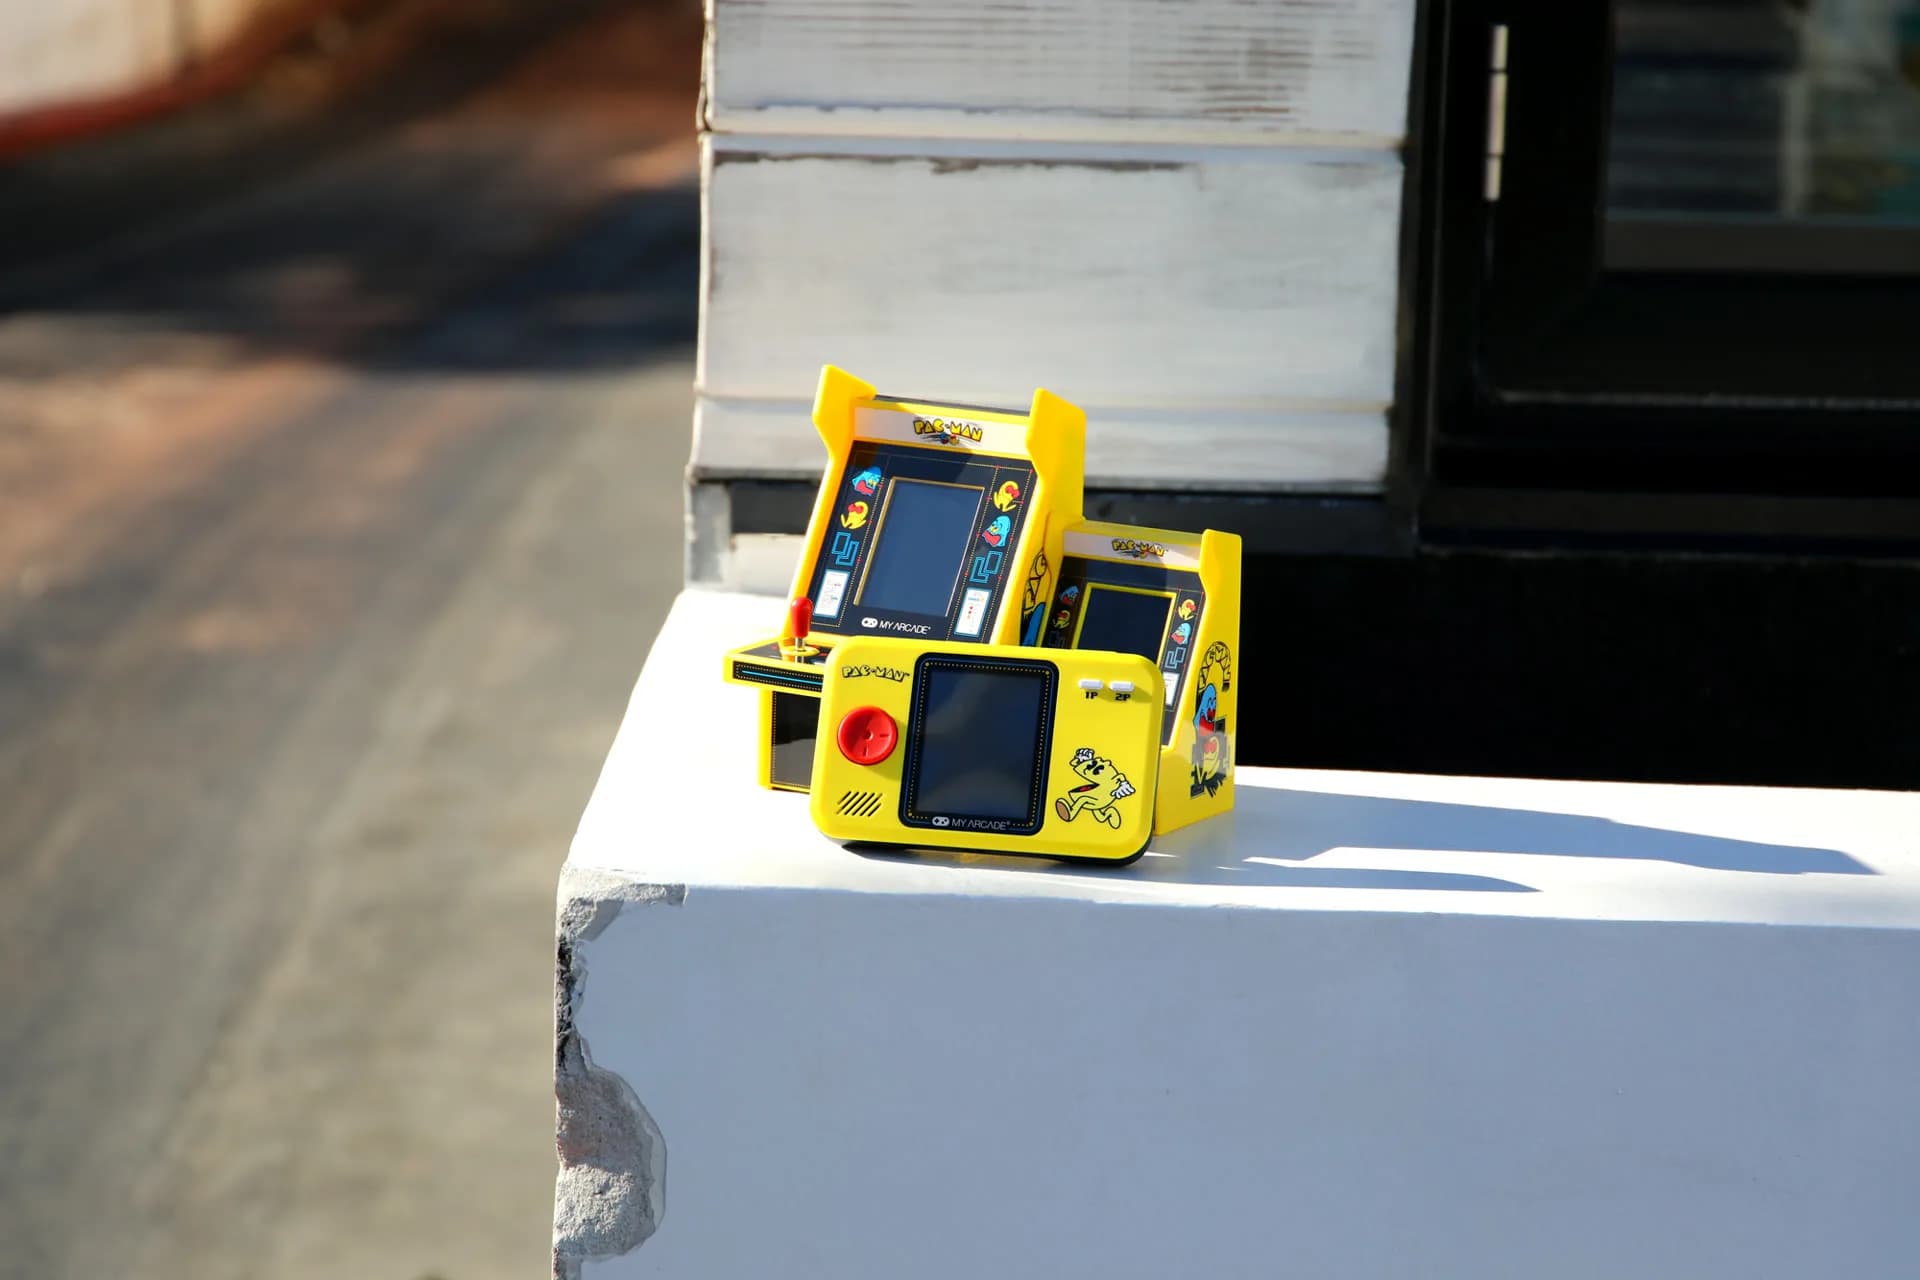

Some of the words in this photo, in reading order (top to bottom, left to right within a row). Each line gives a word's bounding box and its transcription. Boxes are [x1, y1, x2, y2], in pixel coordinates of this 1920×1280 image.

[913, 418, 983, 442] PAC-MAN
[1111, 539, 1166, 557] PAC-MAN
[880, 620, 893, 630] MY
[842, 664, 905, 682] PAC-MAN
[1085, 691, 1098, 699] 1P
[1115, 693, 1131, 702] 2P
[951, 818, 966, 828] MY
